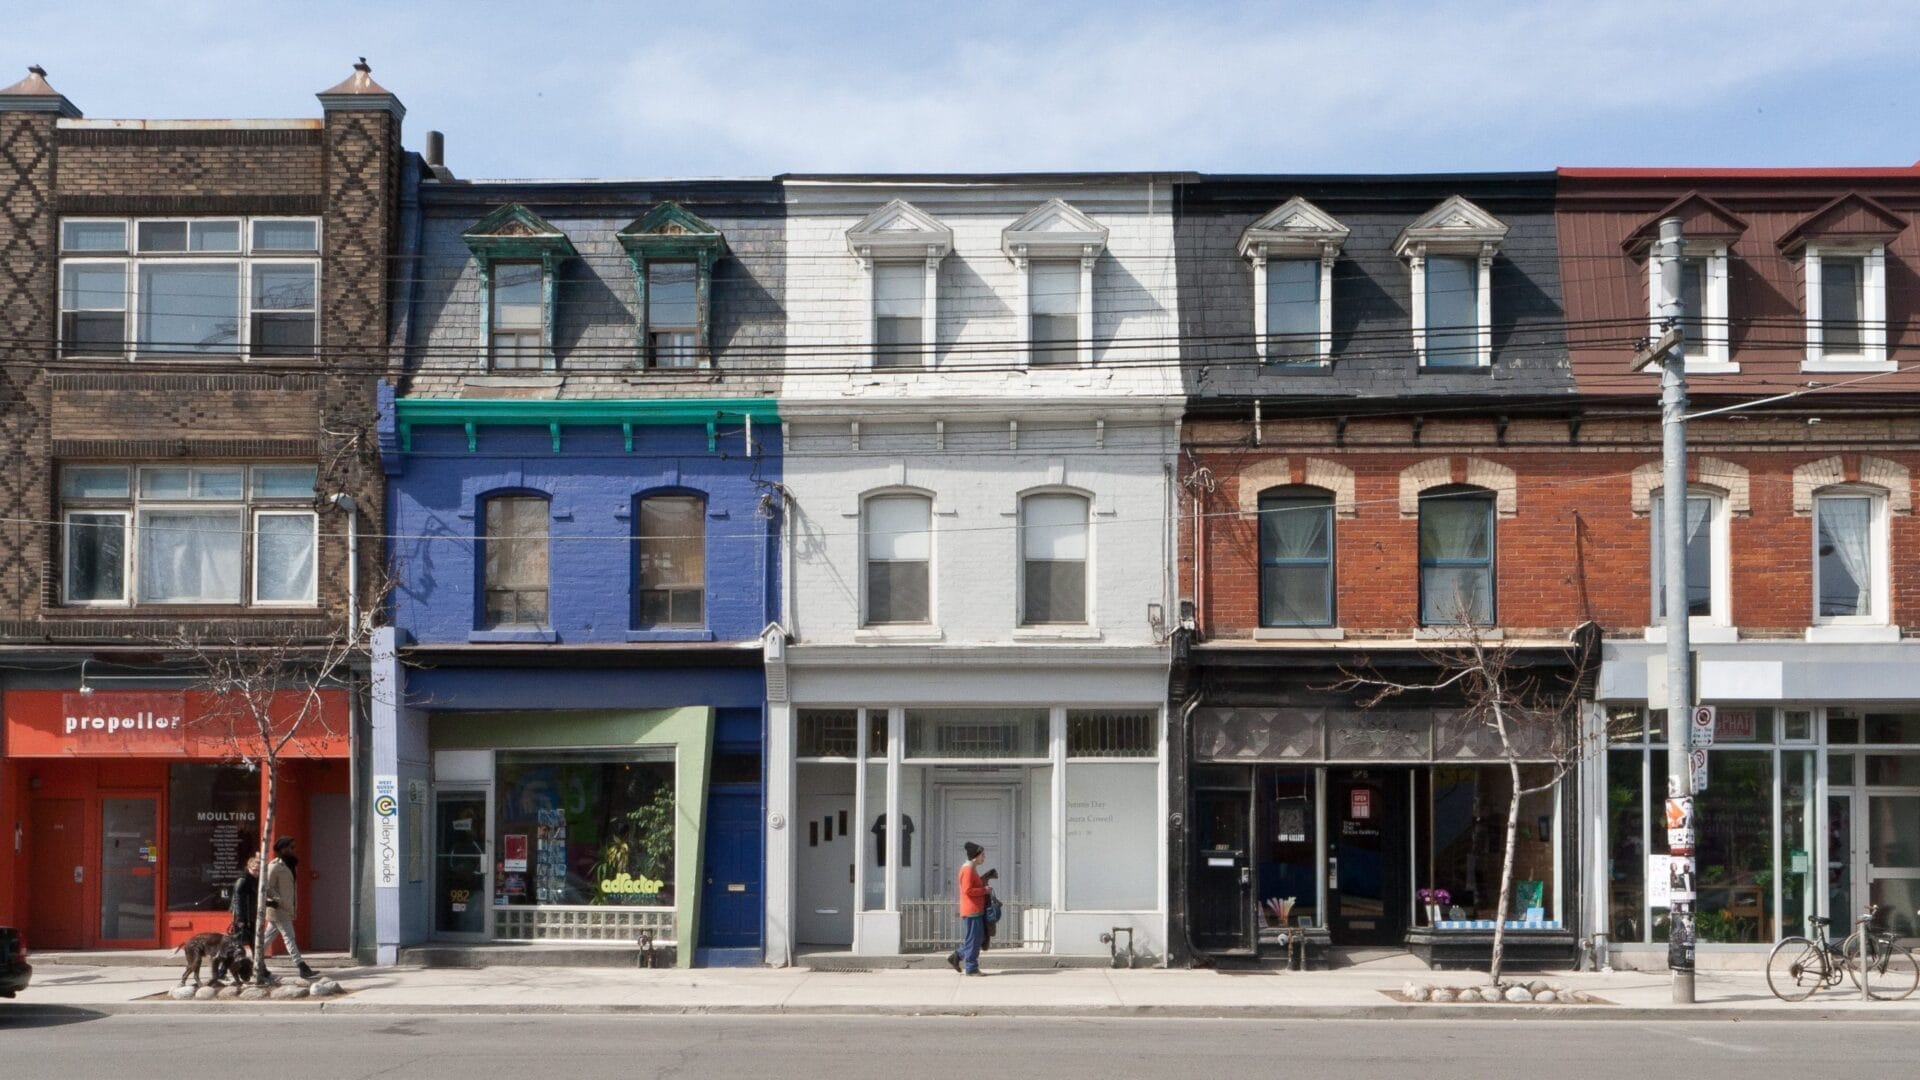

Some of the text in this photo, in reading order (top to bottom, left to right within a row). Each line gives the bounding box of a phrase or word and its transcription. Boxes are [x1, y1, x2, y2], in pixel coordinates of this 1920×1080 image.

[65, 711, 181, 734] propeller
[197, 812, 256, 821] MOULTING
[450, 889, 470, 902] 982
